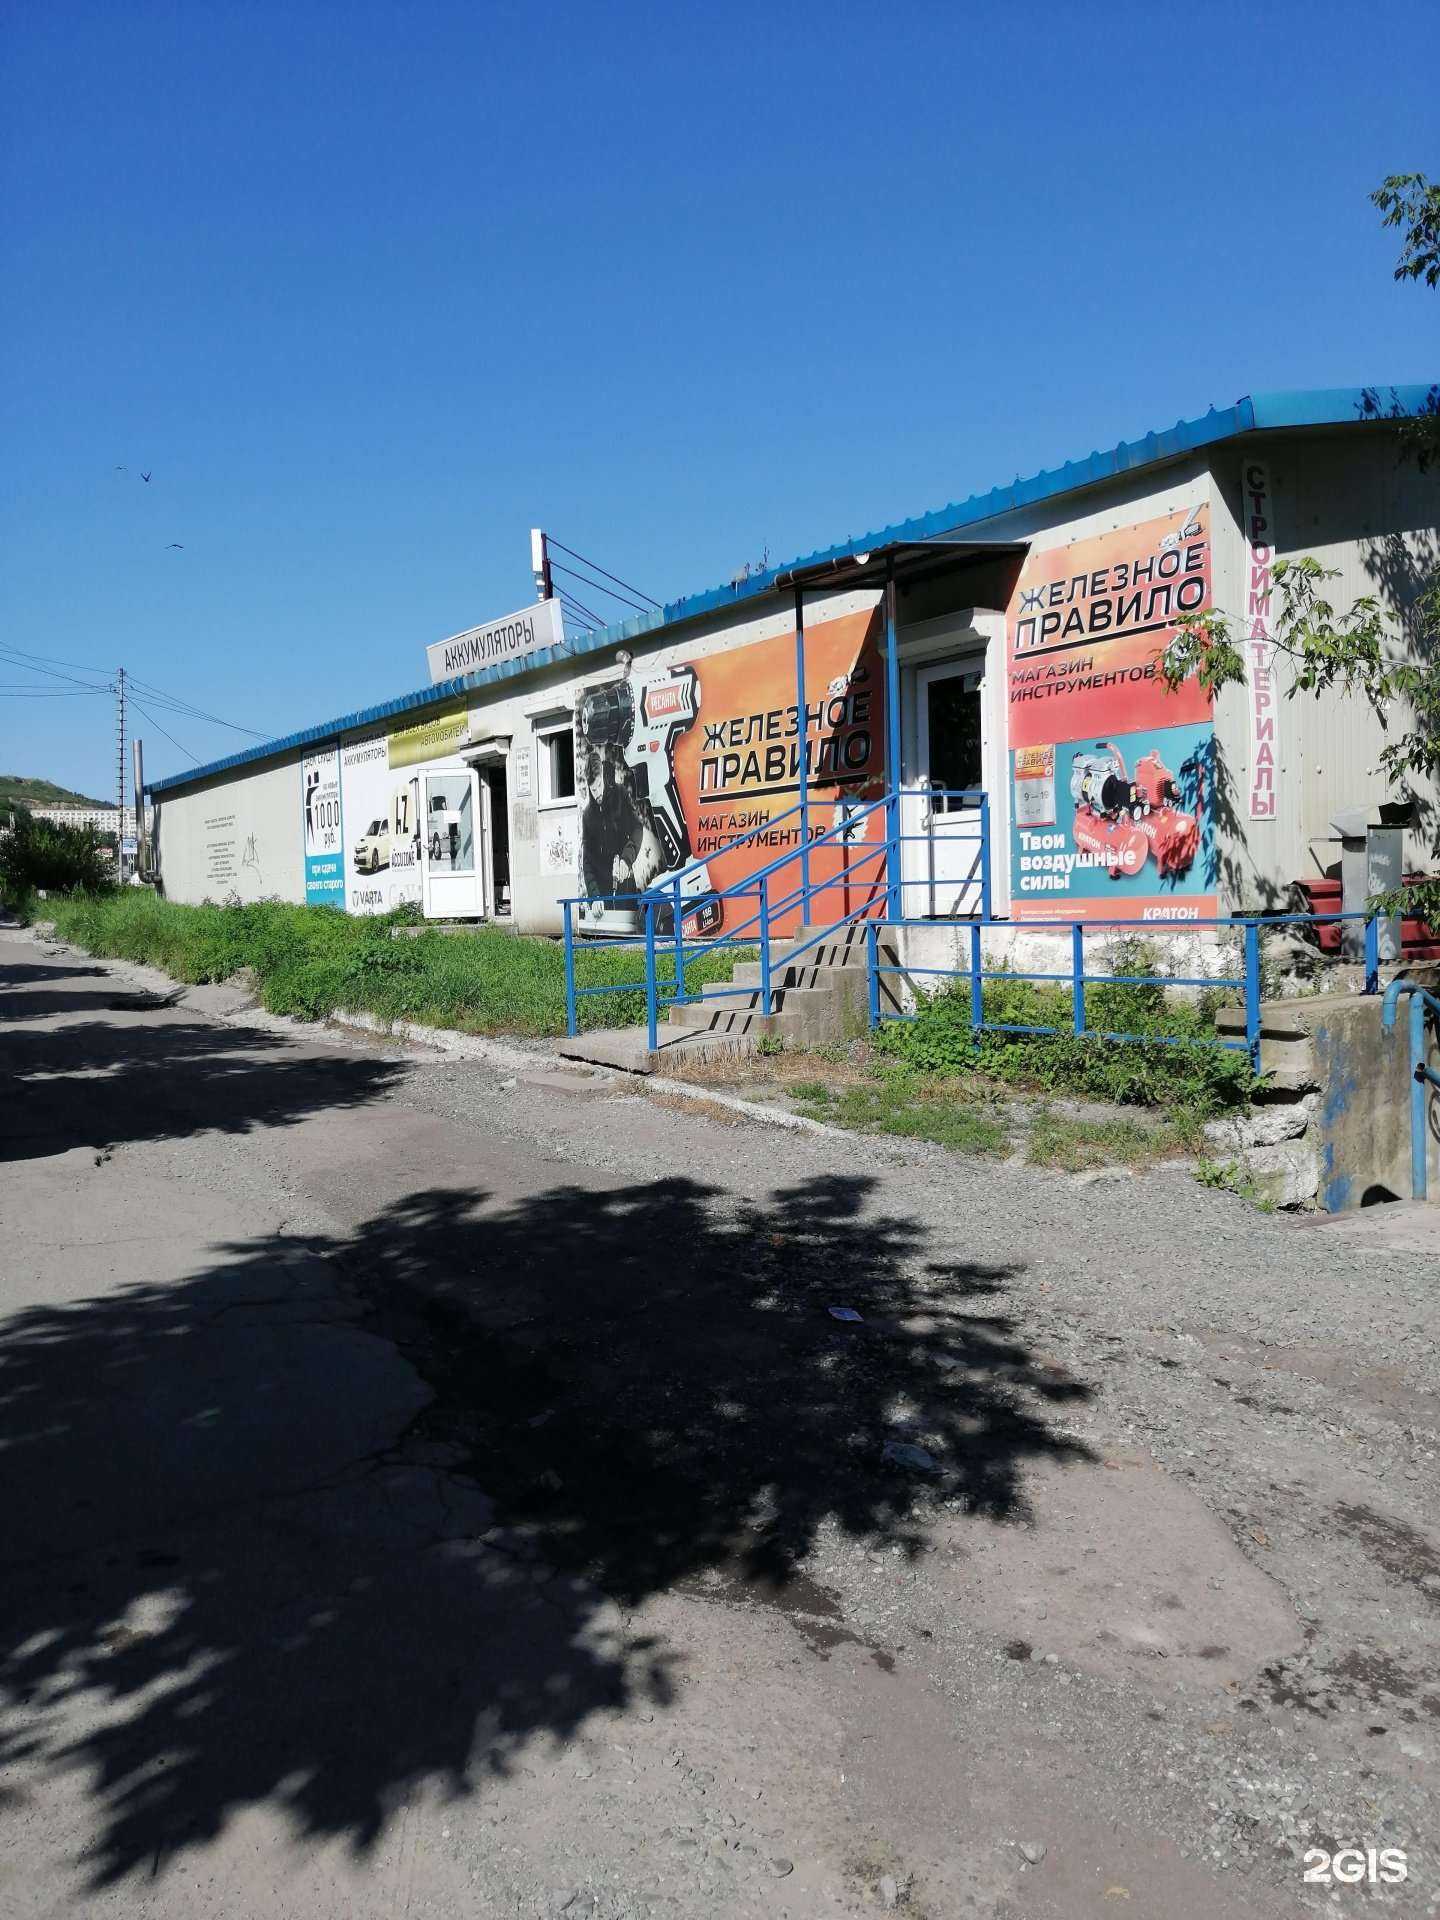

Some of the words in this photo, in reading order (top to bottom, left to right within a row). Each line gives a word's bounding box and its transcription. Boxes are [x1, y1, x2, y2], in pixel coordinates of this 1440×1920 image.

[1019, 541, 1206, 613] ЖЕЛЕЗНОЕ
[1014, 576, 1205, 648] ПРАВИЛО
[445, 617, 535, 672] АККУМУЛЯТОРЫ
[1246, 466, 1275, 816] СТРОЙМАТЕРИАЛЫ
[1010, 656, 1094, 685] МАГАЗИН
[1010, 663, 1156, 703] ИНСТРУМЕНТОВ
[702, 690, 872, 752] ЖЕЛЕЗНОЕ
[699, 730, 872, 791] ПРАВИЛО
[315, 800, 339, 830] 1000
[698, 809, 770, 831] МАГАЗИН
[324, 827, 336, 848] руб.
[1020, 832, 1065, 850] Твои
[1020, 850, 1136, 873] воздушные
[1020, 875, 1069, 890] силы
[360, 890, 383, 905] VARTA
[1143, 907, 1199, 920] КРАТОН
